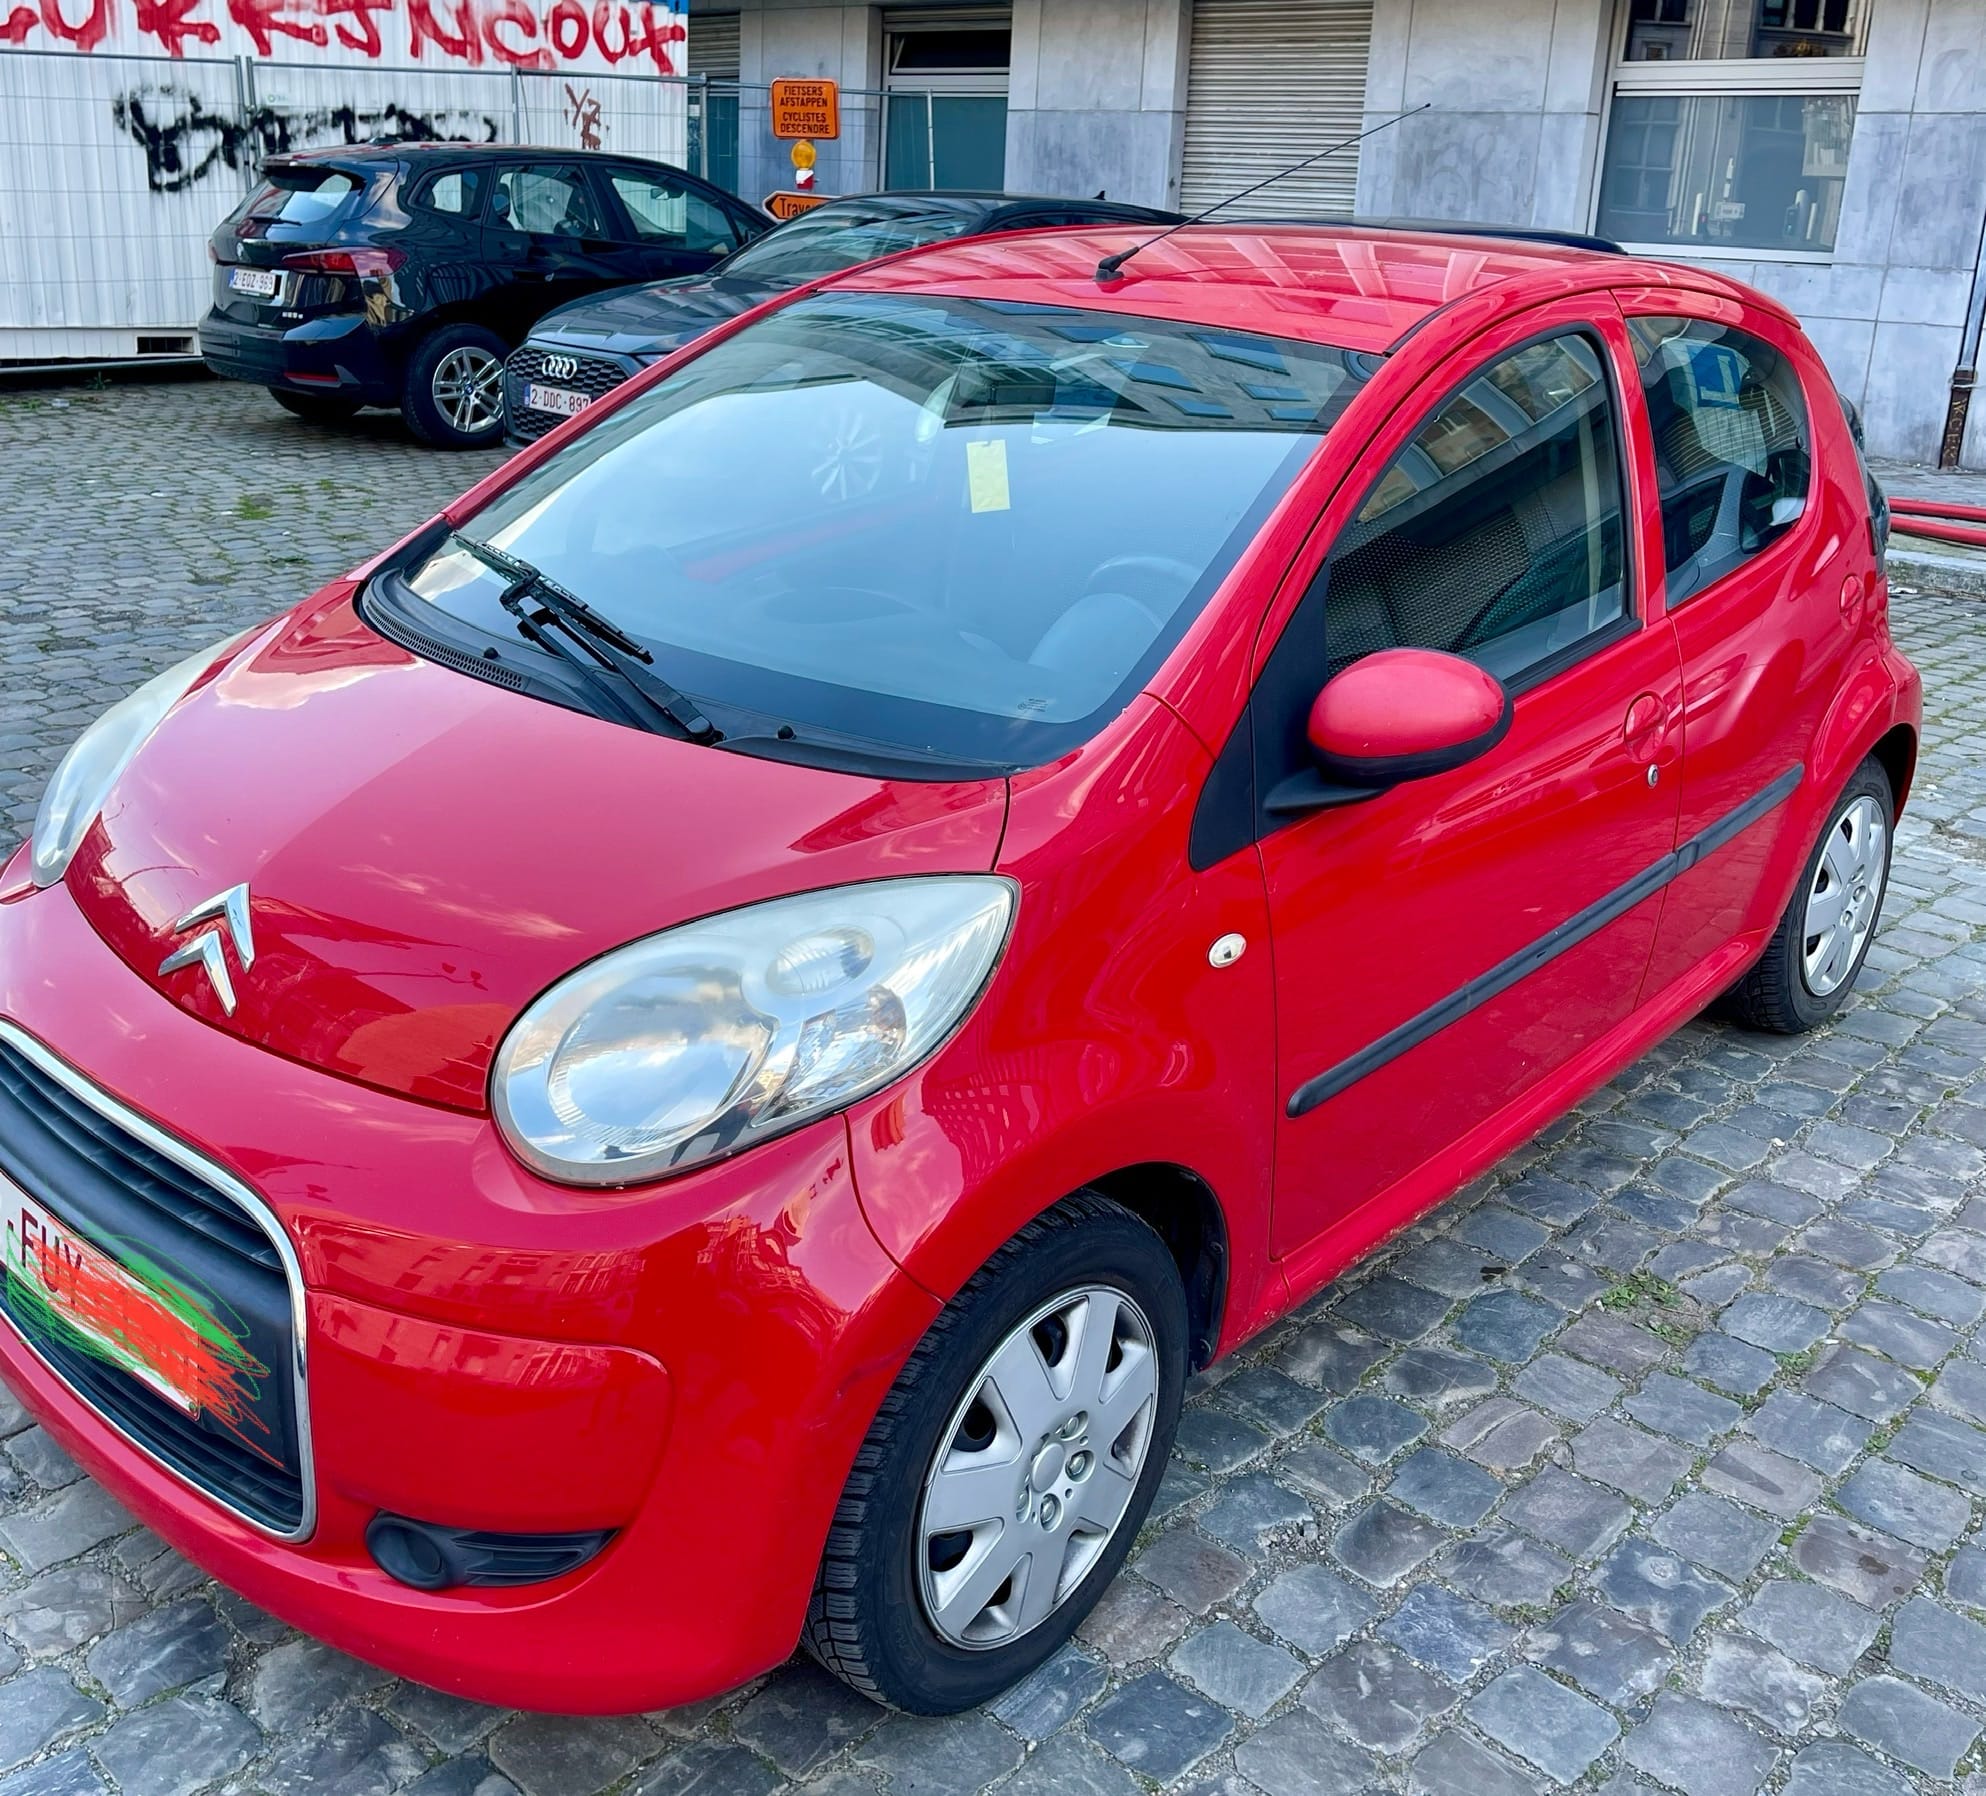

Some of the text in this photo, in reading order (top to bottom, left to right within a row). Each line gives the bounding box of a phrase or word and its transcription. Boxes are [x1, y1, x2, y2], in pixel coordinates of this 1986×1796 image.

[783, 85, 823, 97] FIETSERS
[780, 97, 828, 108] AFSTAPPEN
[782, 111, 826, 123] CYCLISTES
[780, 123, 830, 135] DESCENDRE
